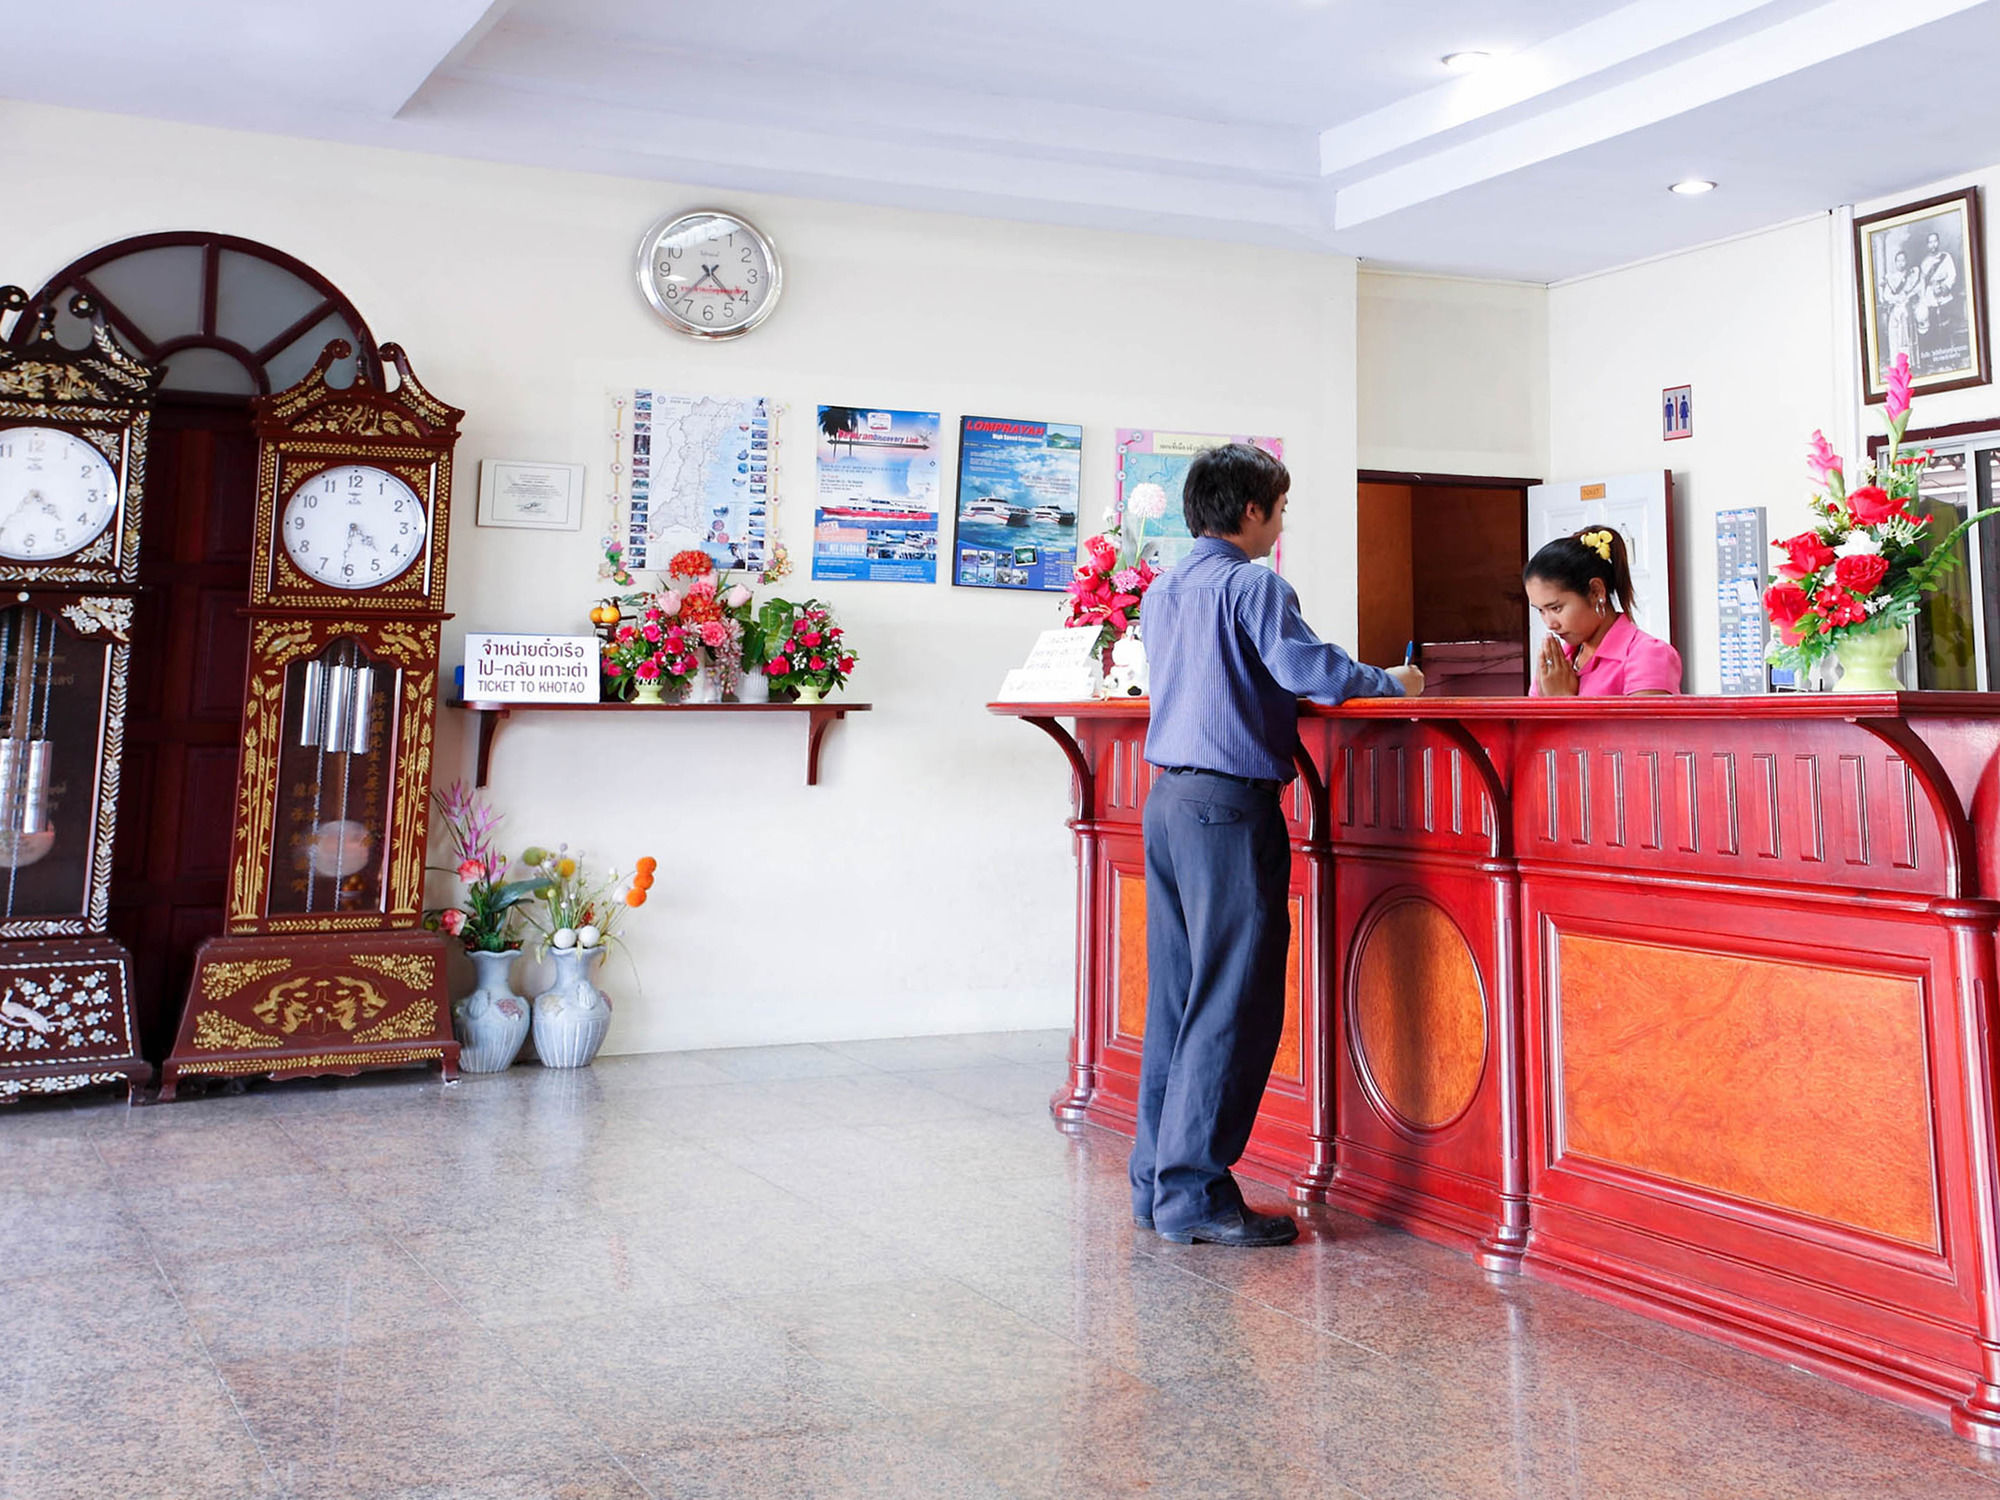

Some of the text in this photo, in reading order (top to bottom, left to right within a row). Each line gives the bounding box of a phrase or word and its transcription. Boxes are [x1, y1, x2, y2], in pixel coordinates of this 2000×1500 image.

[727, 233, 734, 248] 1
[668, 243, 683, 259] 10
[741, 247, 752, 263] 2
[659, 262, 671, 277] 9
[747, 269, 758, 285] 3
[666, 283, 678, 299] 8
[738, 291, 750, 305] 4
[683, 299, 694, 315] 7
[702, 305, 714, 321] 6
[723, 302, 735, 318] 5
[28, 440, 45, 453] 12
[81, 466, 92, 479] 2
[324, 480, 336, 493] 11
[347, 475, 363, 488] 12
[378, 483, 384, 495] 1
[88, 490, 98, 503] 3
[303, 495, 318, 509] 10
[394, 500, 404, 513] 2
[77, 512, 88, 526] 4
[294, 517, 305, 530] 9
[55, 529, 66, 542] 5
[399, 522, 409, 535] 3
[23, 534, 35, 548] 6
[299, 540, 310, 553] 8
[390, 544, 400, 556] 4
[319, 557, 329, 570] 7
[344, 564, 354, 577] 6
[370, 559, 380, 571] 5
[482, 638, 584, 658] จำหน่ายตั๋วเรือ
[478, 659, 588, 678] ไป-กลับ เกาะเต่า
[478, 680, 585, 694] TICKET TO KHOTAO
